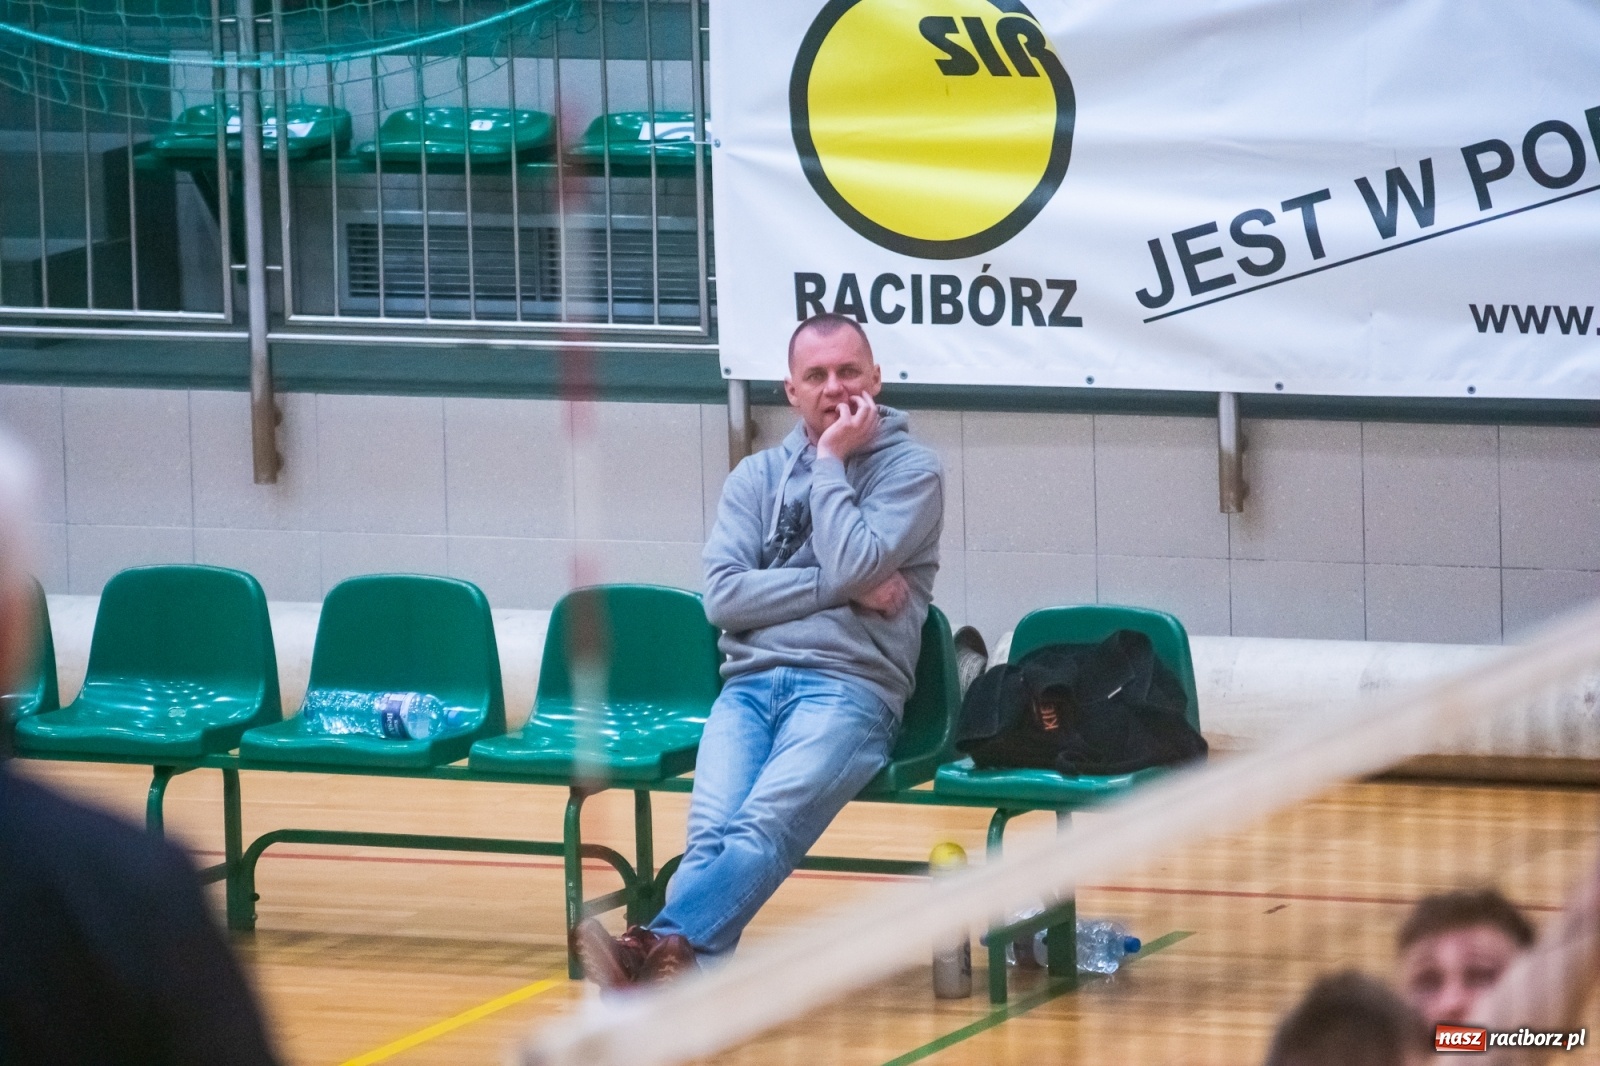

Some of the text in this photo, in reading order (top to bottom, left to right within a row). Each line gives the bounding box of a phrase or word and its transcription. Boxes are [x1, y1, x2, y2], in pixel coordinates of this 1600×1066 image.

[918, 14, 1048, 78] SIR
[1135, 187, 1332, 309] JEST
[1353, 158, 1436, 240] W
[793, 263, 1084, 328] RACIBÓRZ
[1469, 303, 1600, 336] www.
